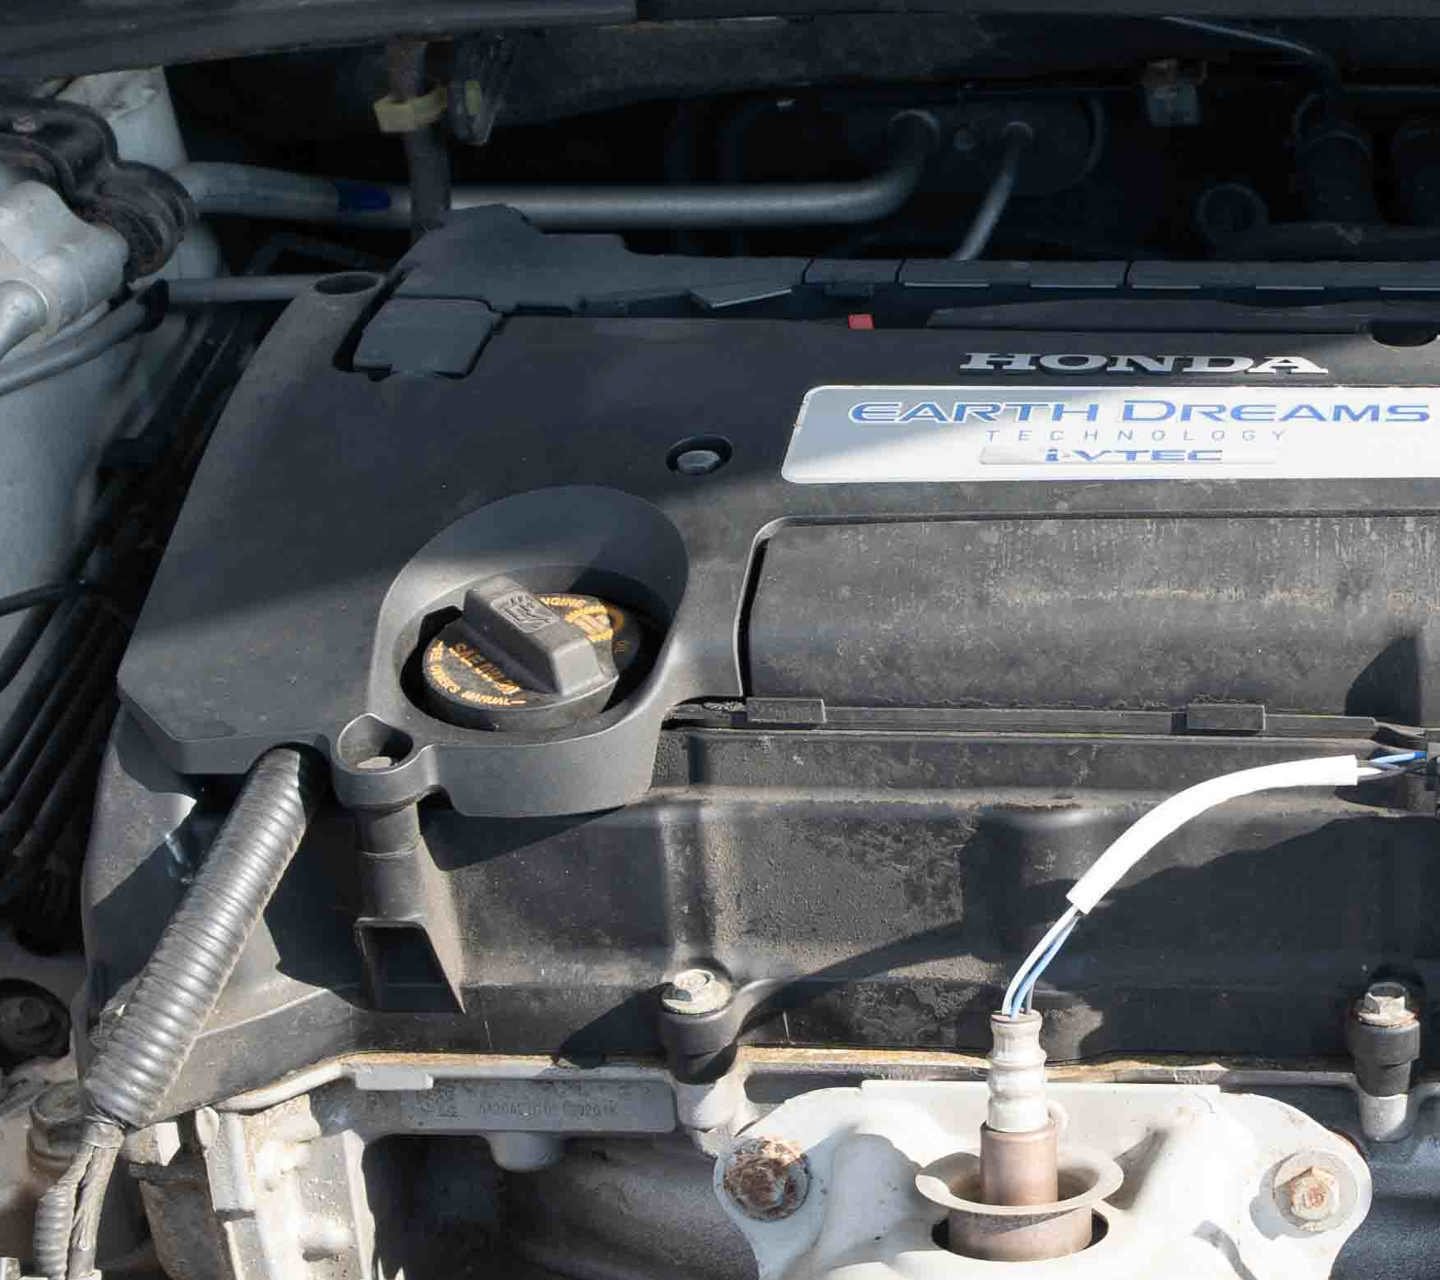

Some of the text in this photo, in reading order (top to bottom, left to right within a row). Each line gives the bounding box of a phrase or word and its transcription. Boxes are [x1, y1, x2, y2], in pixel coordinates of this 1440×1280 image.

[959, 351, 1329, 376] HONDA
[849, 398, 1432, 424] EARTH DREAMS
[987, 429, 1286, 443] TECHNOLOGY
[1044, 448, 1224, 463] i-VTEC
